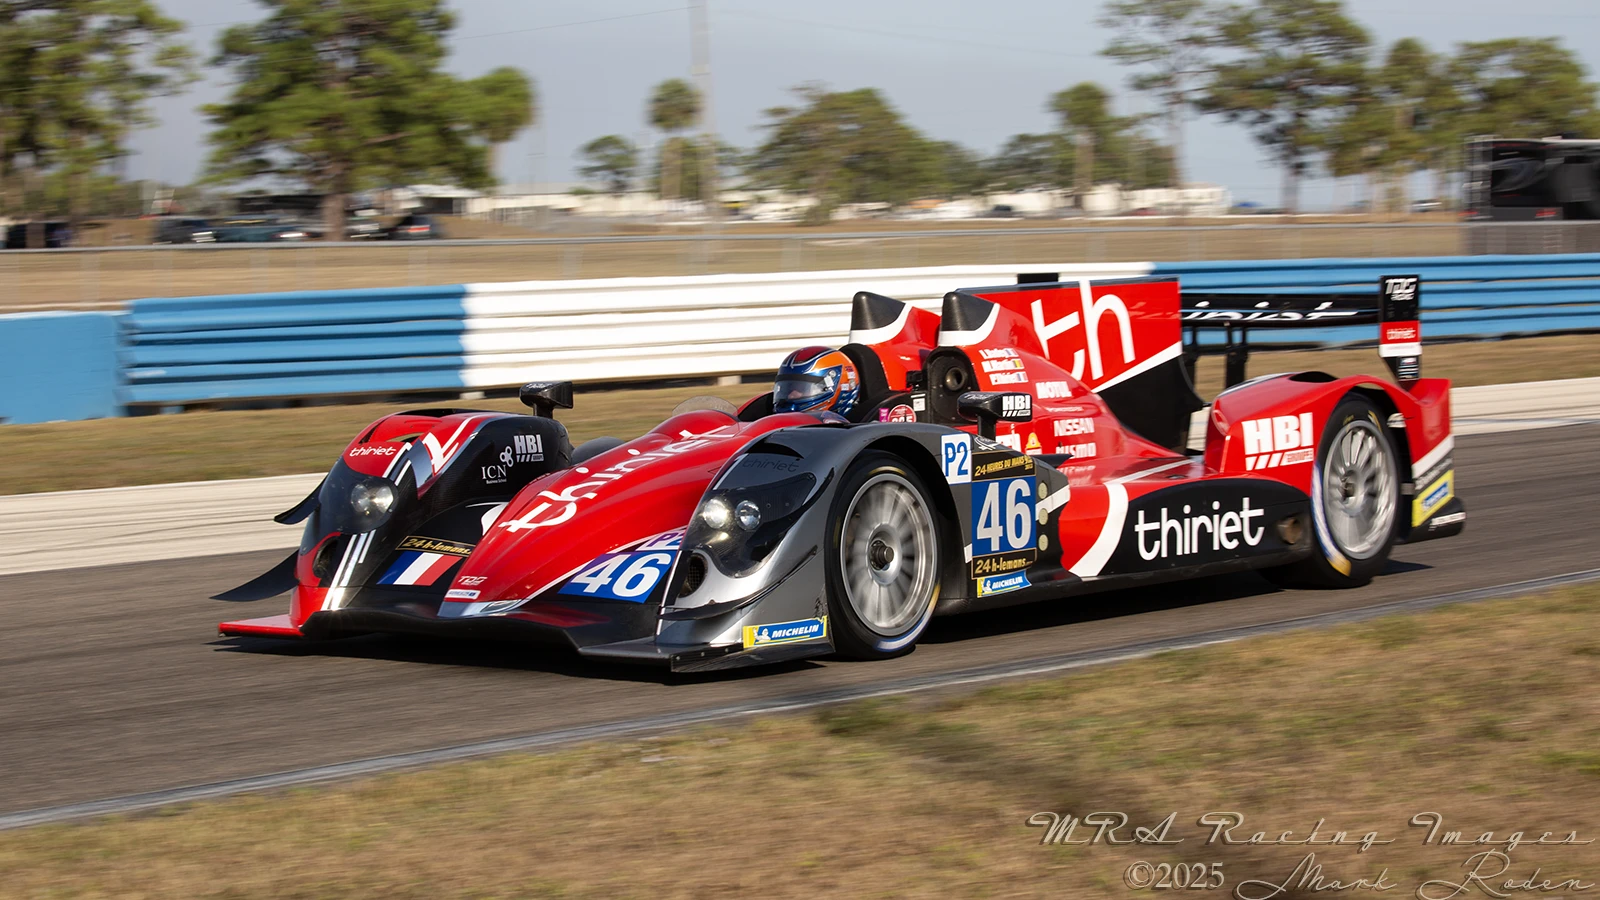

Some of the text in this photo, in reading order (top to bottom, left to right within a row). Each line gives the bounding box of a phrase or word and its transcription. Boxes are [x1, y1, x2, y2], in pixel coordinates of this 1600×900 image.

[1030, 280, 1136, 381] th
[1035, 381, 1073, 399] MOTUL
[1002, 395, 1031, 411] HBI
[1053, 417, 1095, 437] NISSAN
[1241, 412, 1314, 455] HBI
[349, 446, 397, 457] thiriet
[513, 434, 543, 454] HBI
[742, 458, 800, 473] thiriet
[944, 441, 969, 477] P2
[481, 464, 507, 480] ICN
[498, 425, 736, 533] thiriet
[974, 464, 987, 477] 24
[976, 479, 1033, 552] 46
[1134, 497, 1265, 561] thiriet
[570, 553, 672, 598] 46
[992, 575, 1024, 590] MICHELIN
[771, 624, 820, 639] MICHELIN
